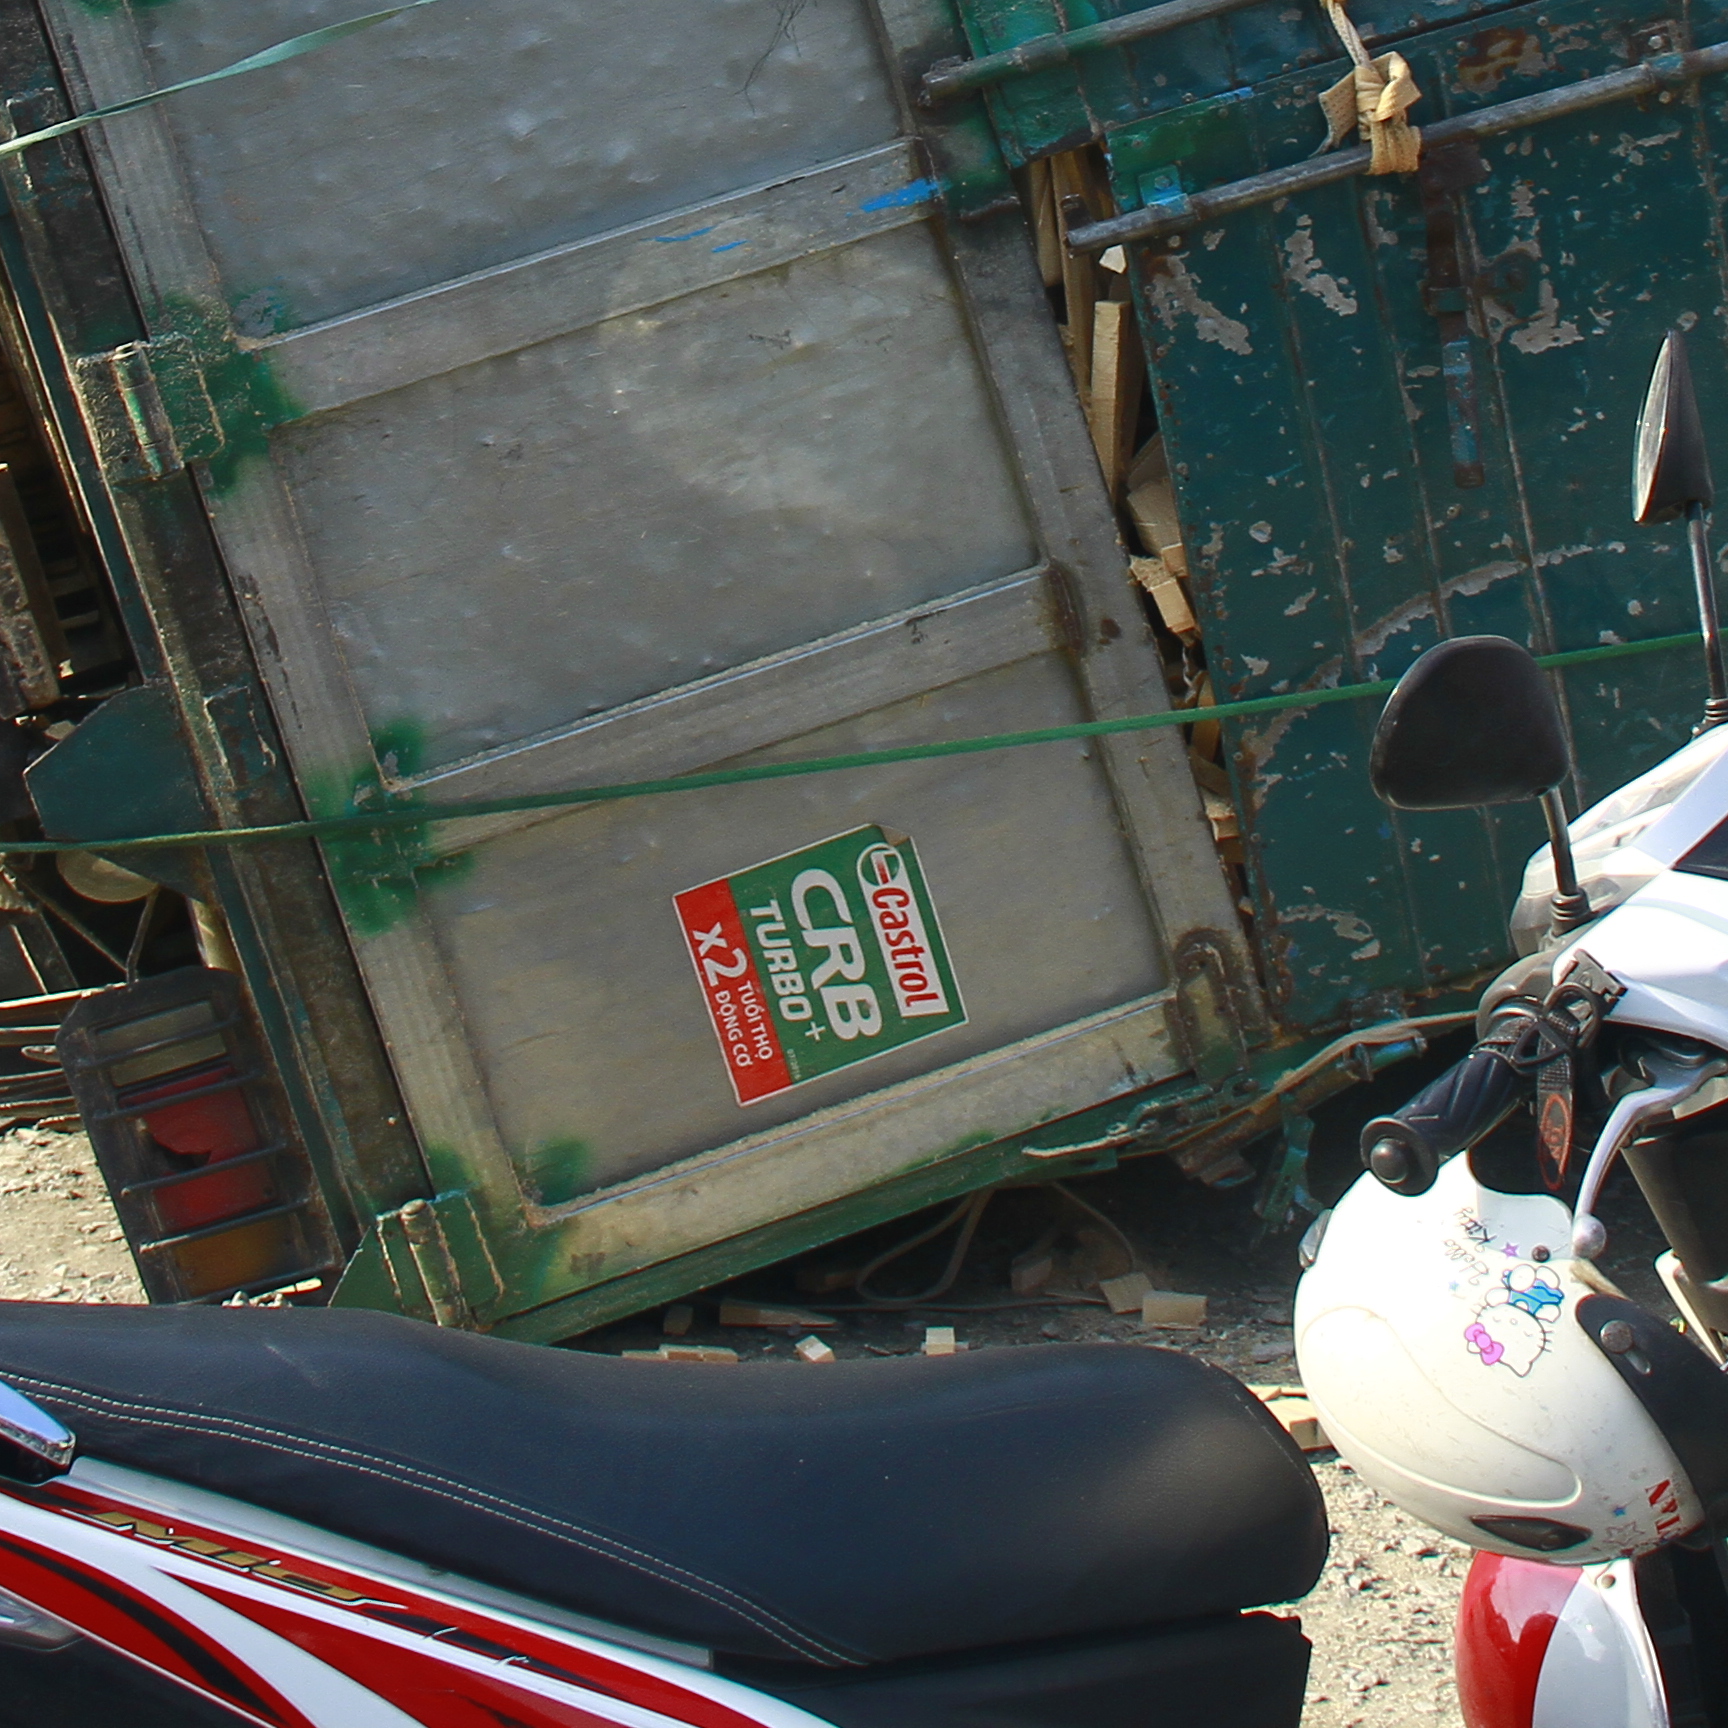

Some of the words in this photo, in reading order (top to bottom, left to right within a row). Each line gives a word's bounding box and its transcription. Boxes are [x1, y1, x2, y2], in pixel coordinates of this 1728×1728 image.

[691, 921, 748, 987] x2
[790, 867, 884, 1042] CRB
[871, 886, 941, 1009] Castrol
[714, 989, 744, 1042] ĐỘNG
[732, 1043, 754, 1067] CƠ
[737, 979, 765, 1024] TUỔI
[750, 1022, 774, 1060] THỌ
[1453, 1206, 1498, 1253] Kitty
[1441, 1238, 1490, 1286] Hello
